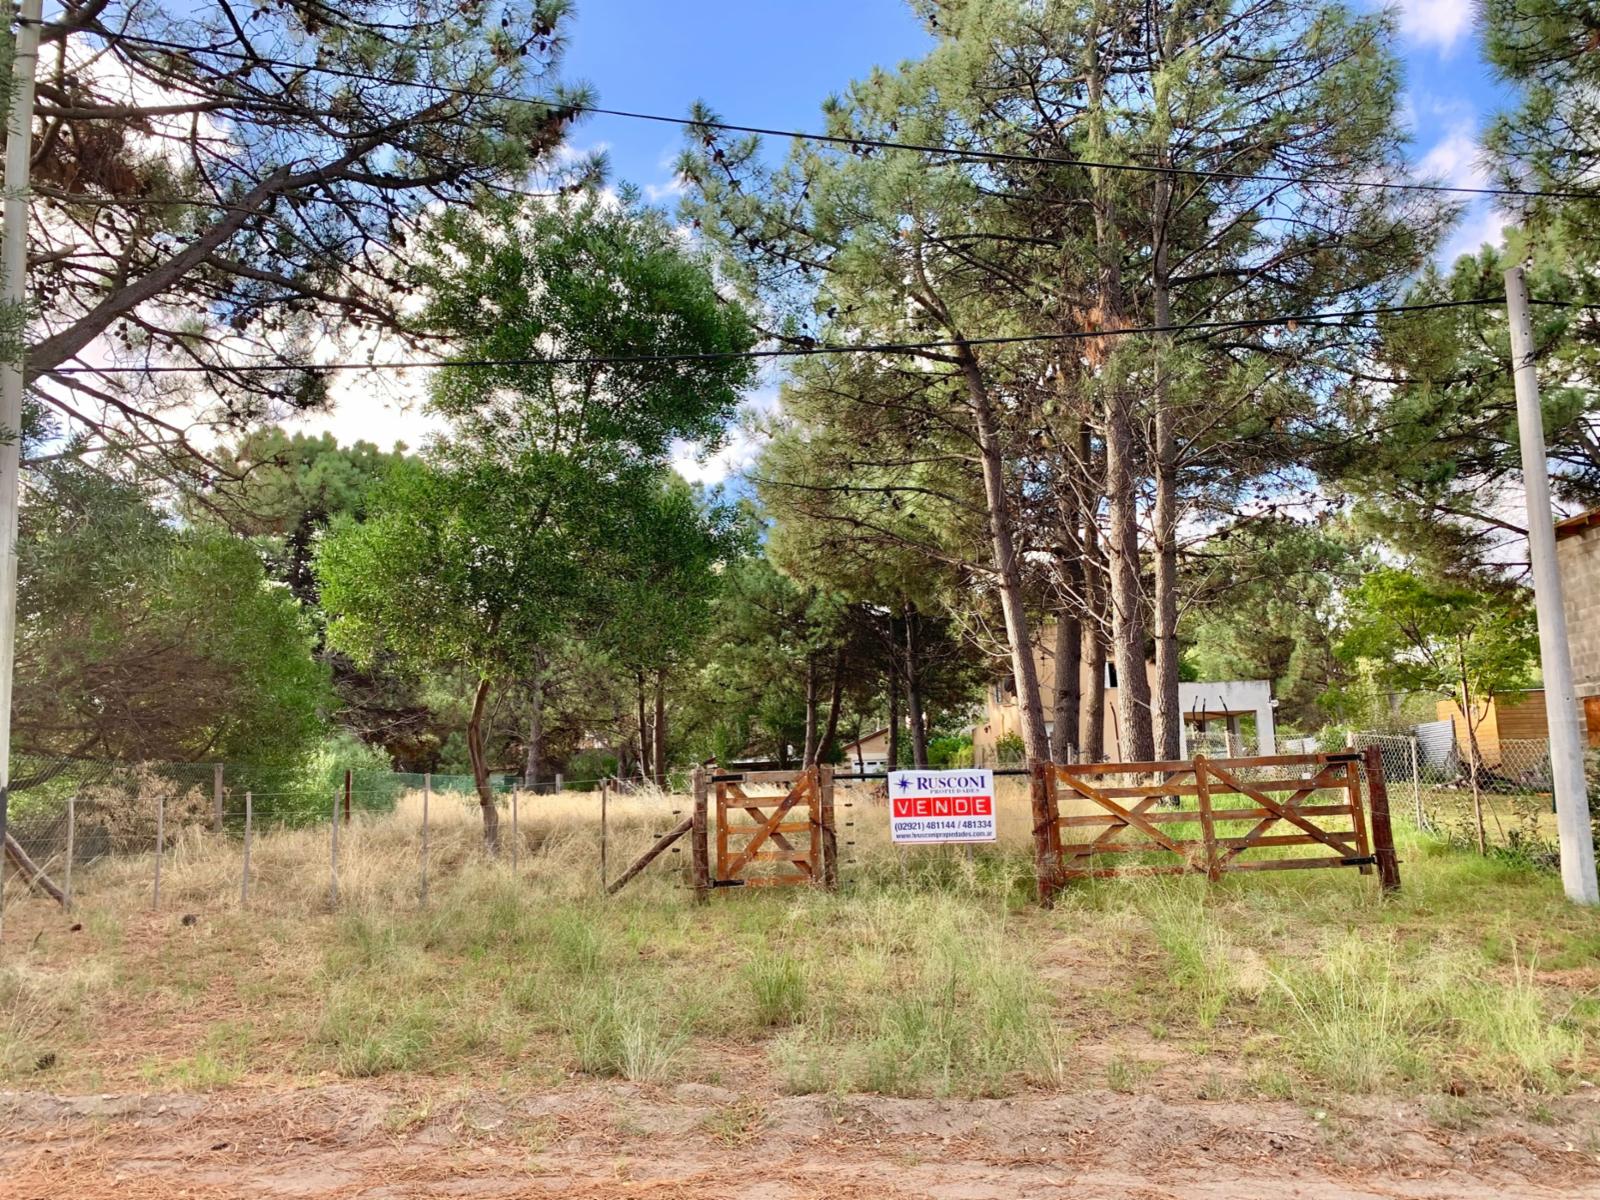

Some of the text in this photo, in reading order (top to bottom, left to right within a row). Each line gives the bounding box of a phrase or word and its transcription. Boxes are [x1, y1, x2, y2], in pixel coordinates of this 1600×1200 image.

[917, 776, 986, 790] RUSCONI
[897, 799, 987, 815] VENDE
[894, 822, 925, 832] (02921)
[926, 821, 956, 829] 481144
[962, 820, 992, 829] 481334
